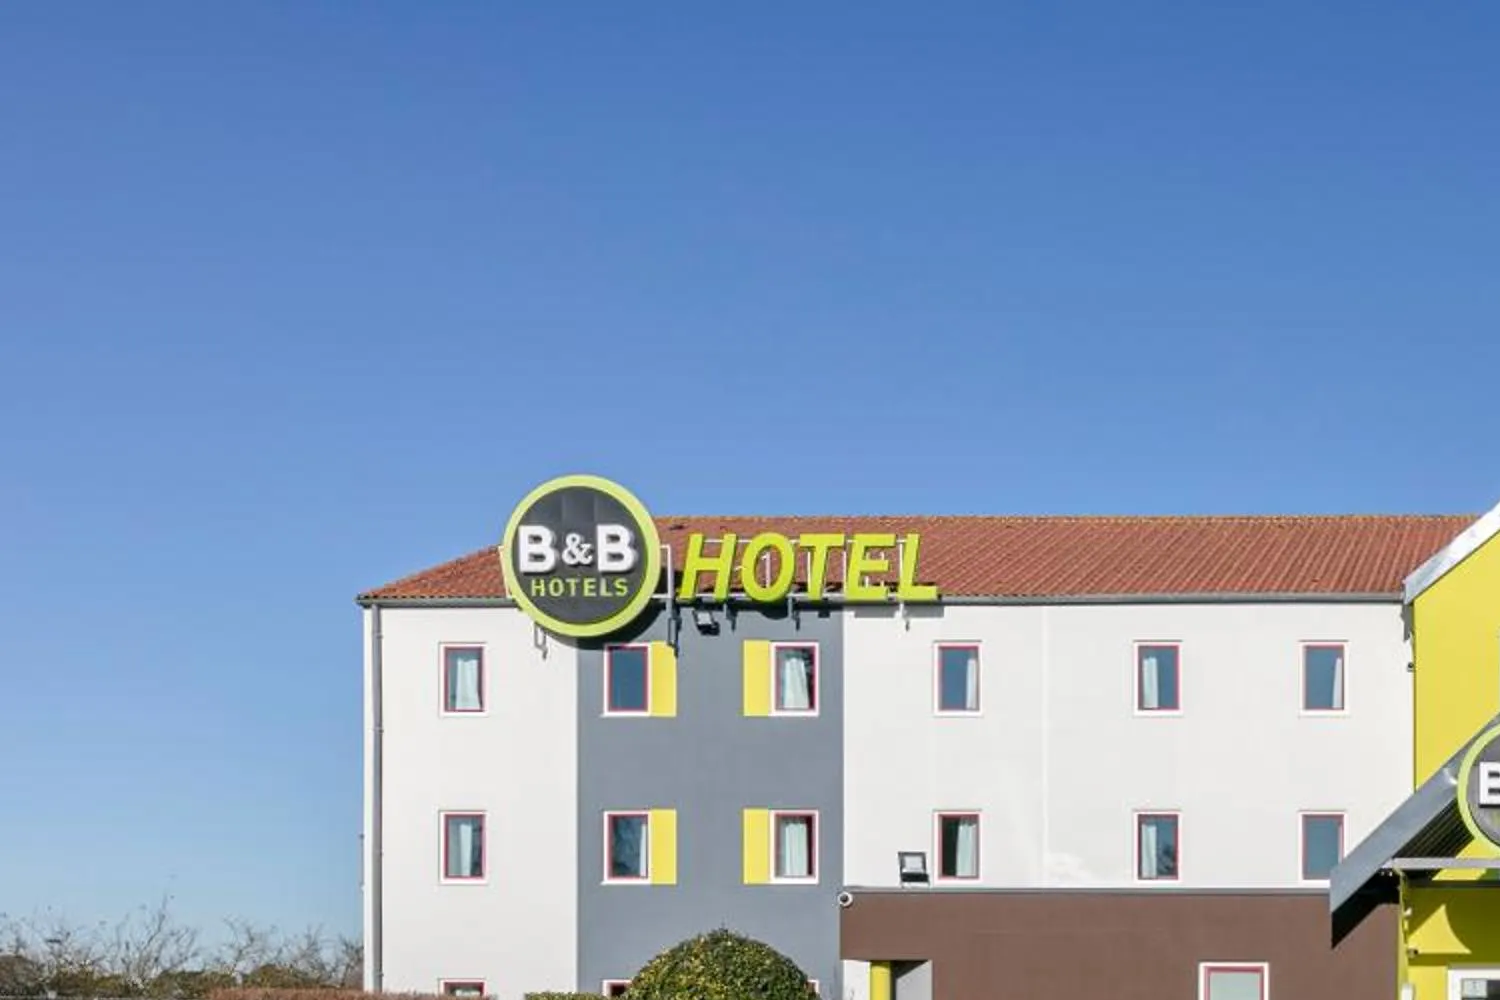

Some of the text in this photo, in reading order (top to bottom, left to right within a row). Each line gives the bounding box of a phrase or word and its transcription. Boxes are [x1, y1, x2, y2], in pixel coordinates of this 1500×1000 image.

[518, 525, 637, 573] B&B
[676, 533, 939, 602] HOTEL
[531, 577, 627, 597] HOTELS
